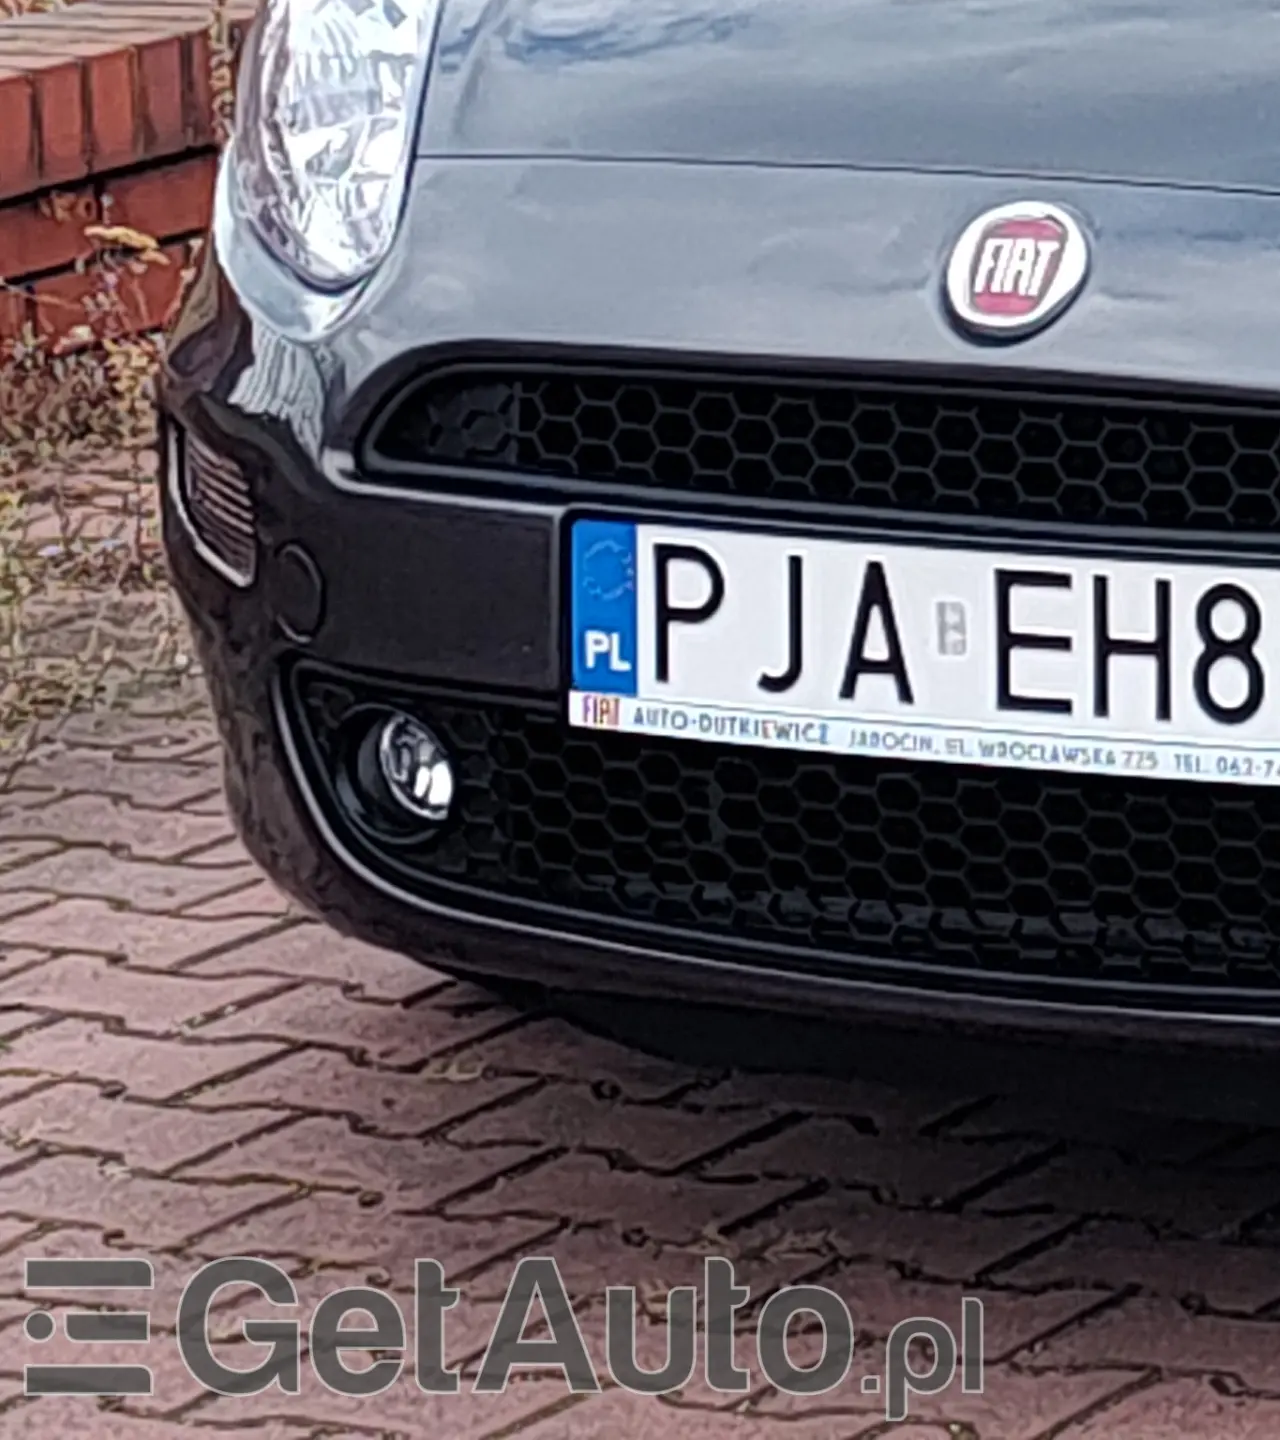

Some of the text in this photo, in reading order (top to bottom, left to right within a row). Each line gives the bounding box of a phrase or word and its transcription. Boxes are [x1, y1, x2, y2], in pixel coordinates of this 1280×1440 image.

[974, 237, 1061, 296] FIAT
[584, 629, 632, 672] PL
[582, 695, 620, 726] FIAT
